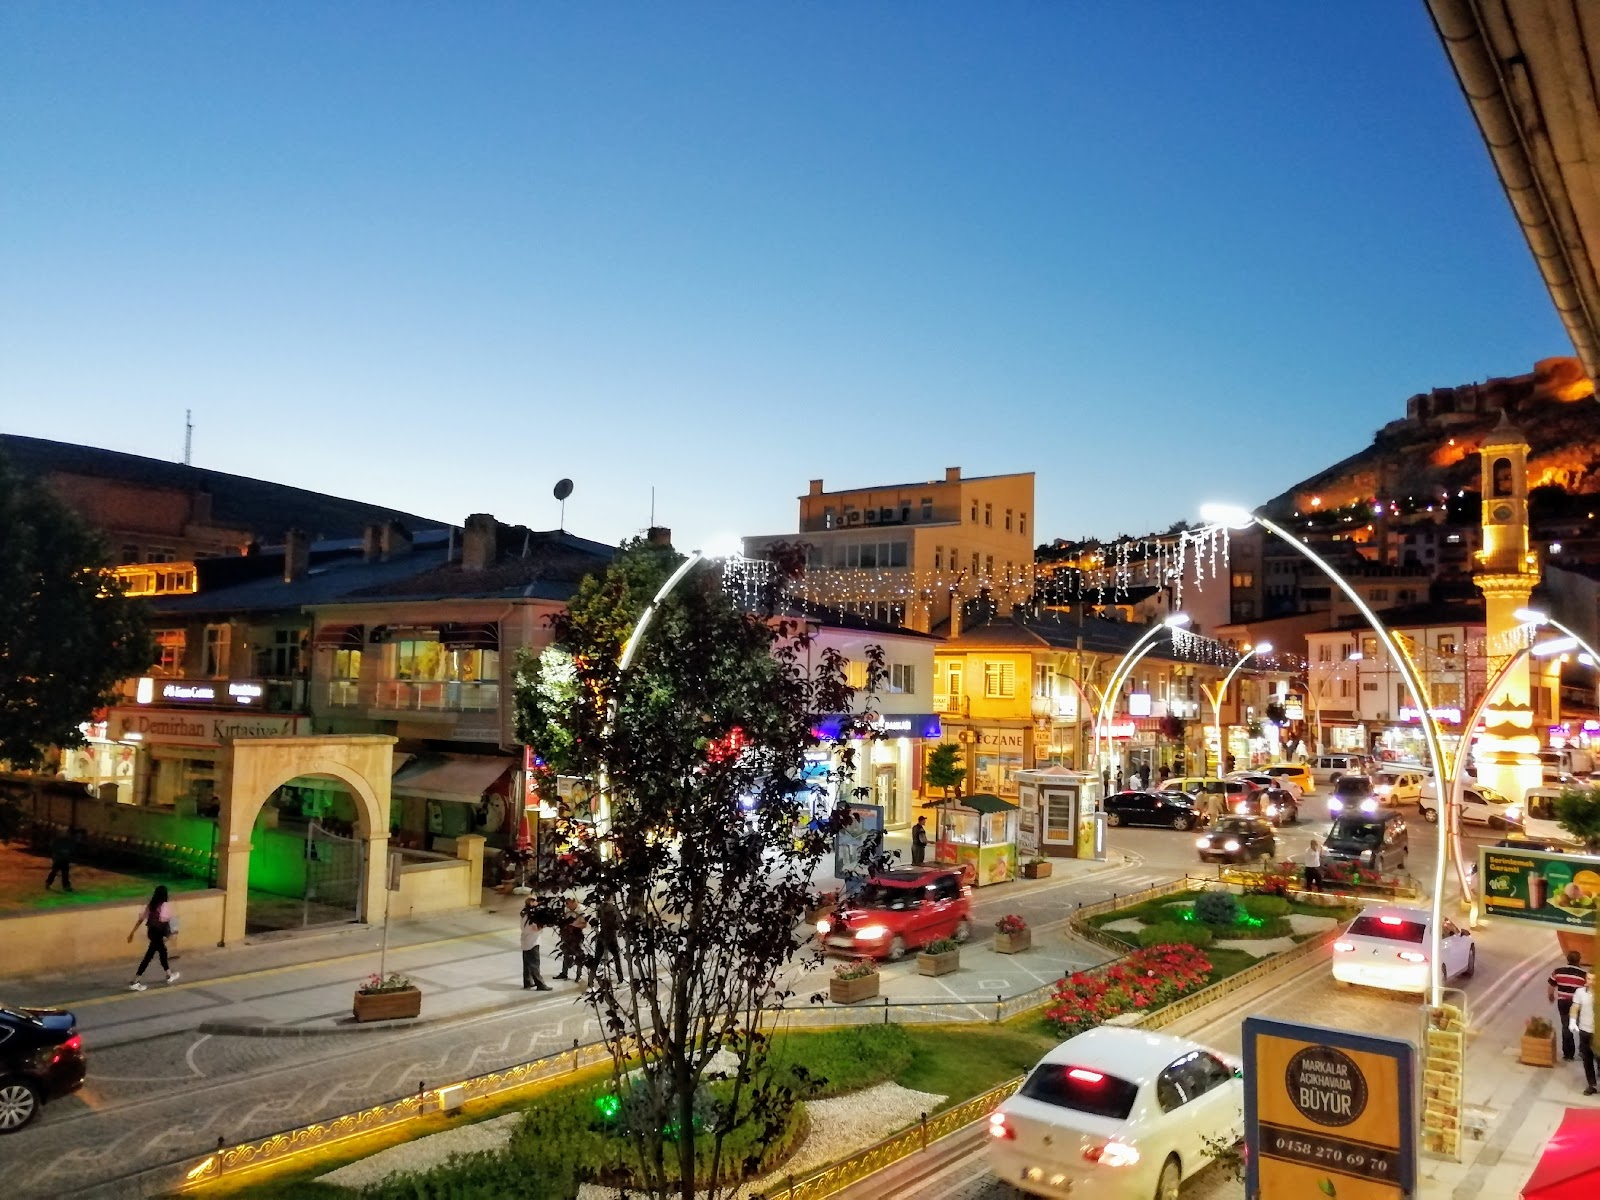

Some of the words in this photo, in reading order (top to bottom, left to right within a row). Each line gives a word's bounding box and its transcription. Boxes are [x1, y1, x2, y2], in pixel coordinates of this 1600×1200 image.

[138, 716, 205, 737] Demirhan
[977, 734, 1023, 747] ECZANE
[1489, 863, 1520, 874] Garanti
[1302, 1058, 1348, 1077] MARKALAR
[1299, 1071, 1352, 1091] AÇIKHAVADA
[1300, 1086, 1352, 1117] BÜYÜR
[1275, 1137, 1312, 1155] 0458
[1315, 1146, 1343, 1161] 270
[1346, 1153, 1365, 1167] 69
[1370, 1158, 1388, 1172] 70
